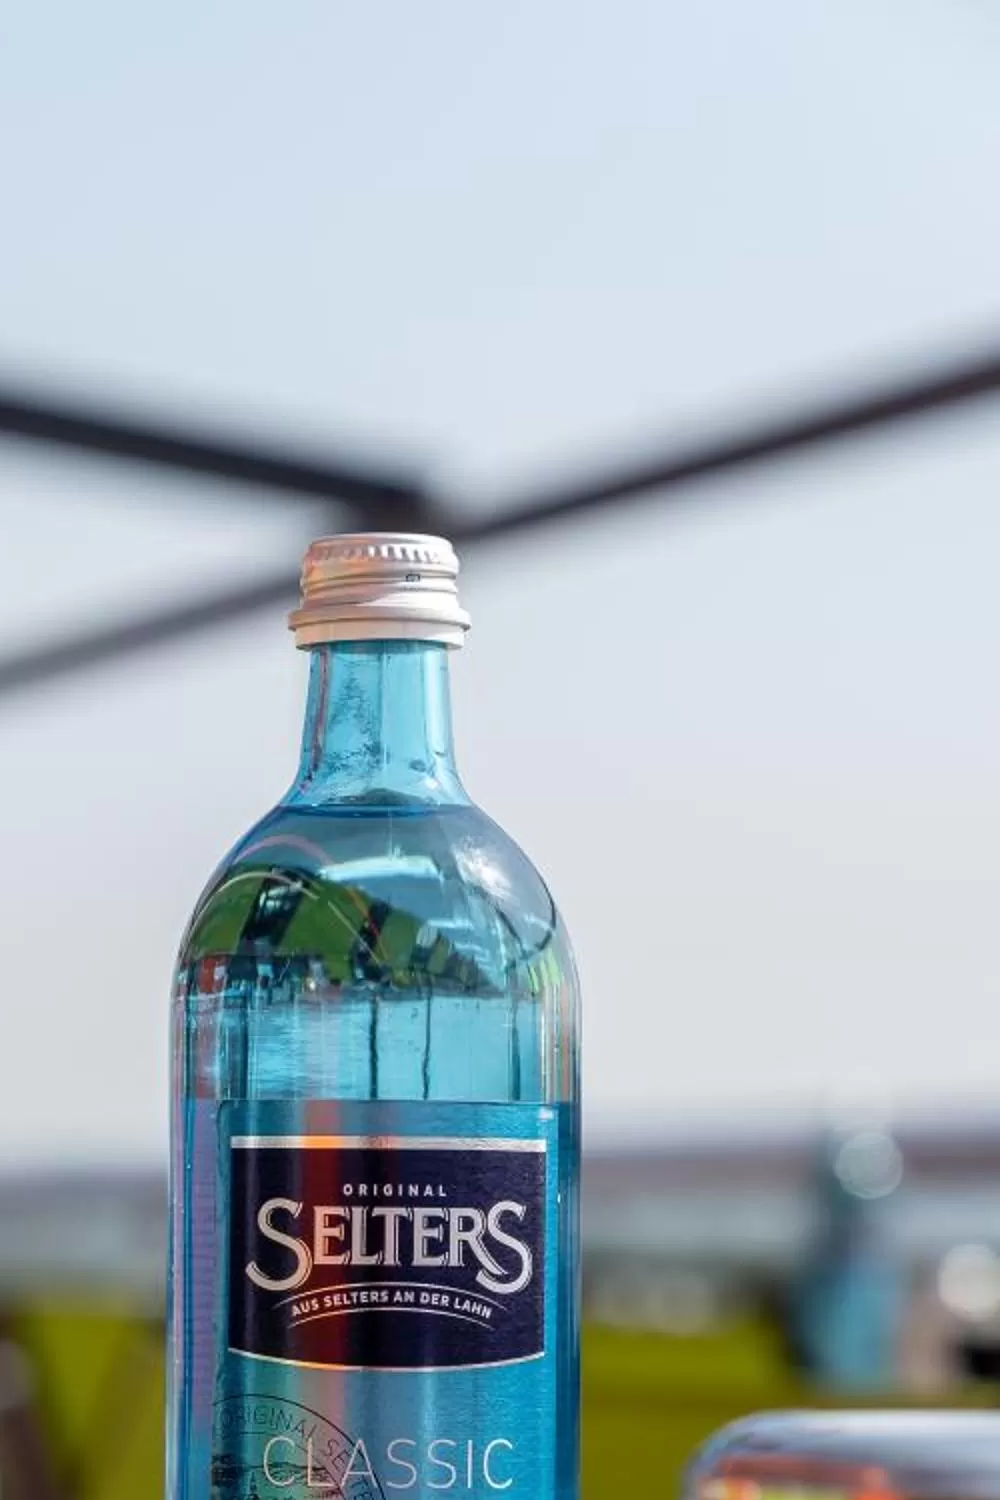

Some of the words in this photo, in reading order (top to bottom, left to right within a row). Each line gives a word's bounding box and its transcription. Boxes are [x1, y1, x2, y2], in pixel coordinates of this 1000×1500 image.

[343, 1183, 447, 1197] ORIGINAL
[245, 1197, 533, 1294] SELTERS
[291, 1297, 319, 1317] AUS
[323, 1291, 389, 1308] SELTERS
[393, 1291, 415, 1304] AN
[420, 1292, 450, 1307] DER
[453, 1297, 493, 1319] LAHN
[263, 1434, 514, 1490] CLASSIC
